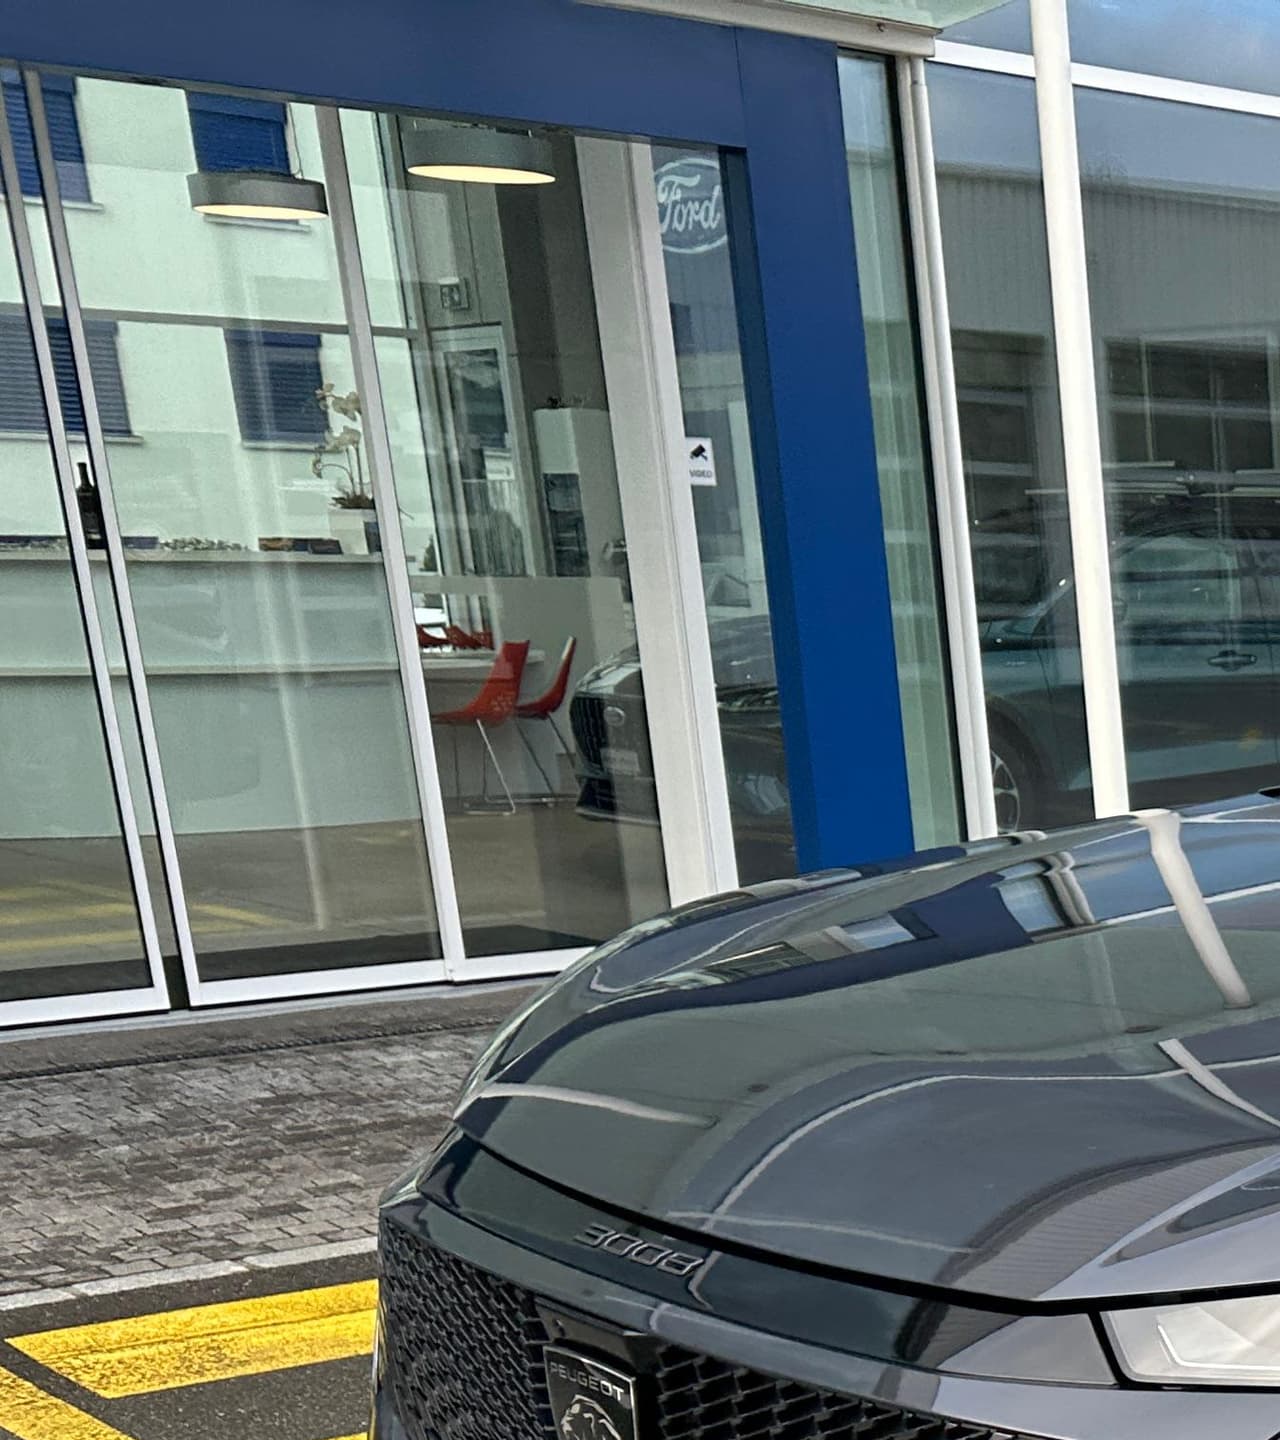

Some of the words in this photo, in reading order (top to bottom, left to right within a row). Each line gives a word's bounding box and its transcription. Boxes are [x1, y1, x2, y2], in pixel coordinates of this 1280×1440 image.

[657, 174, 722, 233] Ford
[574, 1222, 704, 1277] 3008
[549, 1361, 625, 1402] PEUGEOT
